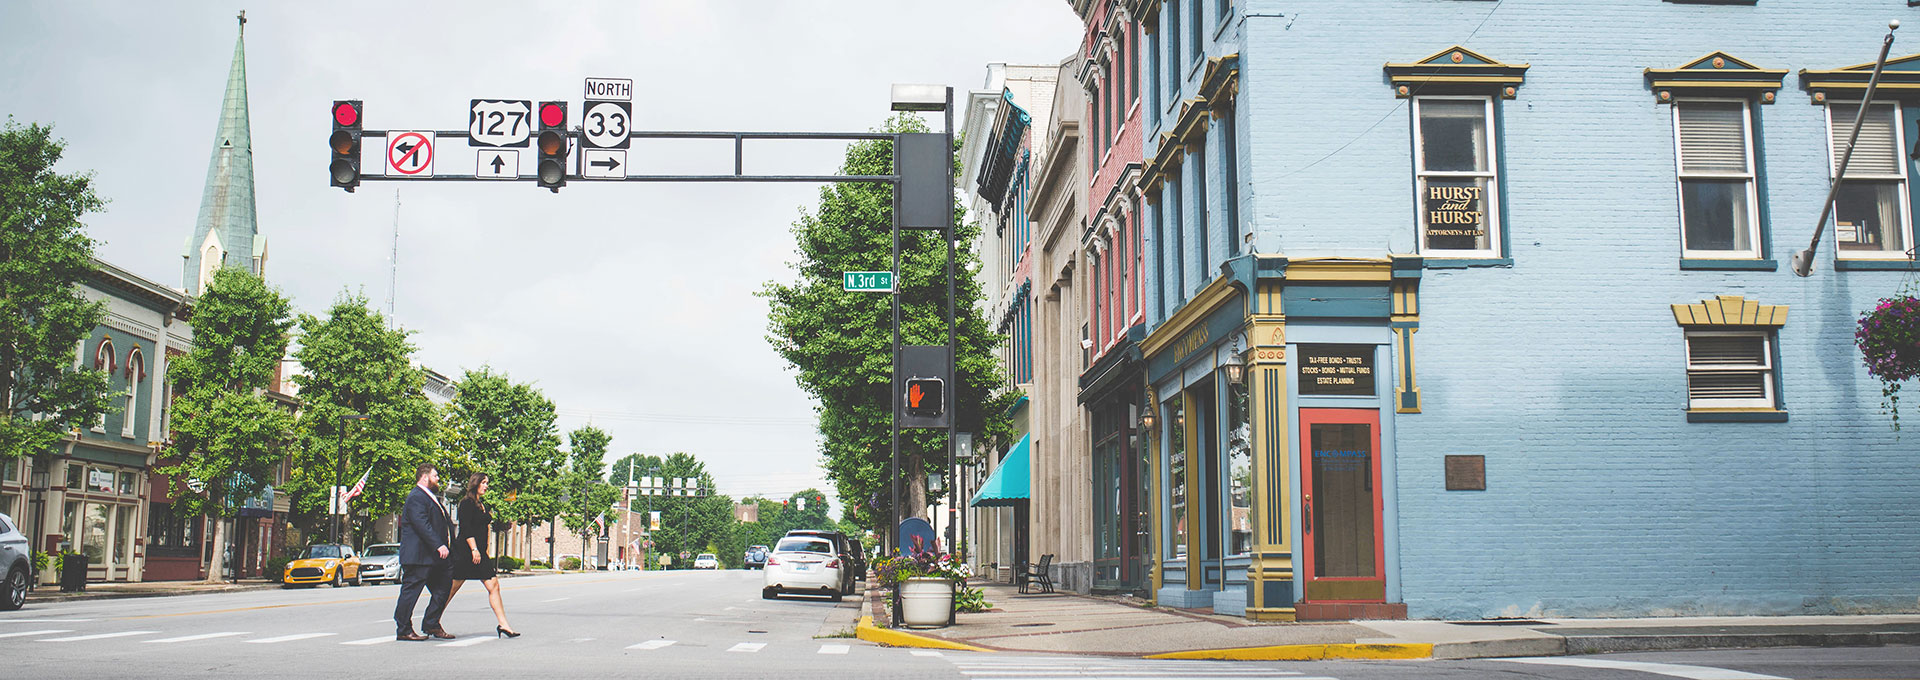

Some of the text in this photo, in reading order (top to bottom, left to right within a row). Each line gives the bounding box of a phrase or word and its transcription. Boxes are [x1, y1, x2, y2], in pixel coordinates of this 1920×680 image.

[587, 81, 630, 96] NORTH
[477, 111, 525, 136] 127
[588, 112, 626, 137] 33
[1430, 186, 1482, 200] HURST
[1437, 199, 1471, 210] and
[1431, 211, 1482, 224] HURST
[1309, 356, 1328, 364] TAX-FREE
[1329, 356, 1343, 364] BONDS
[1317, 377, 1355, 385] ESTATE PLANNING
[1314, 449, 1367, 458] ENCOMPASS
